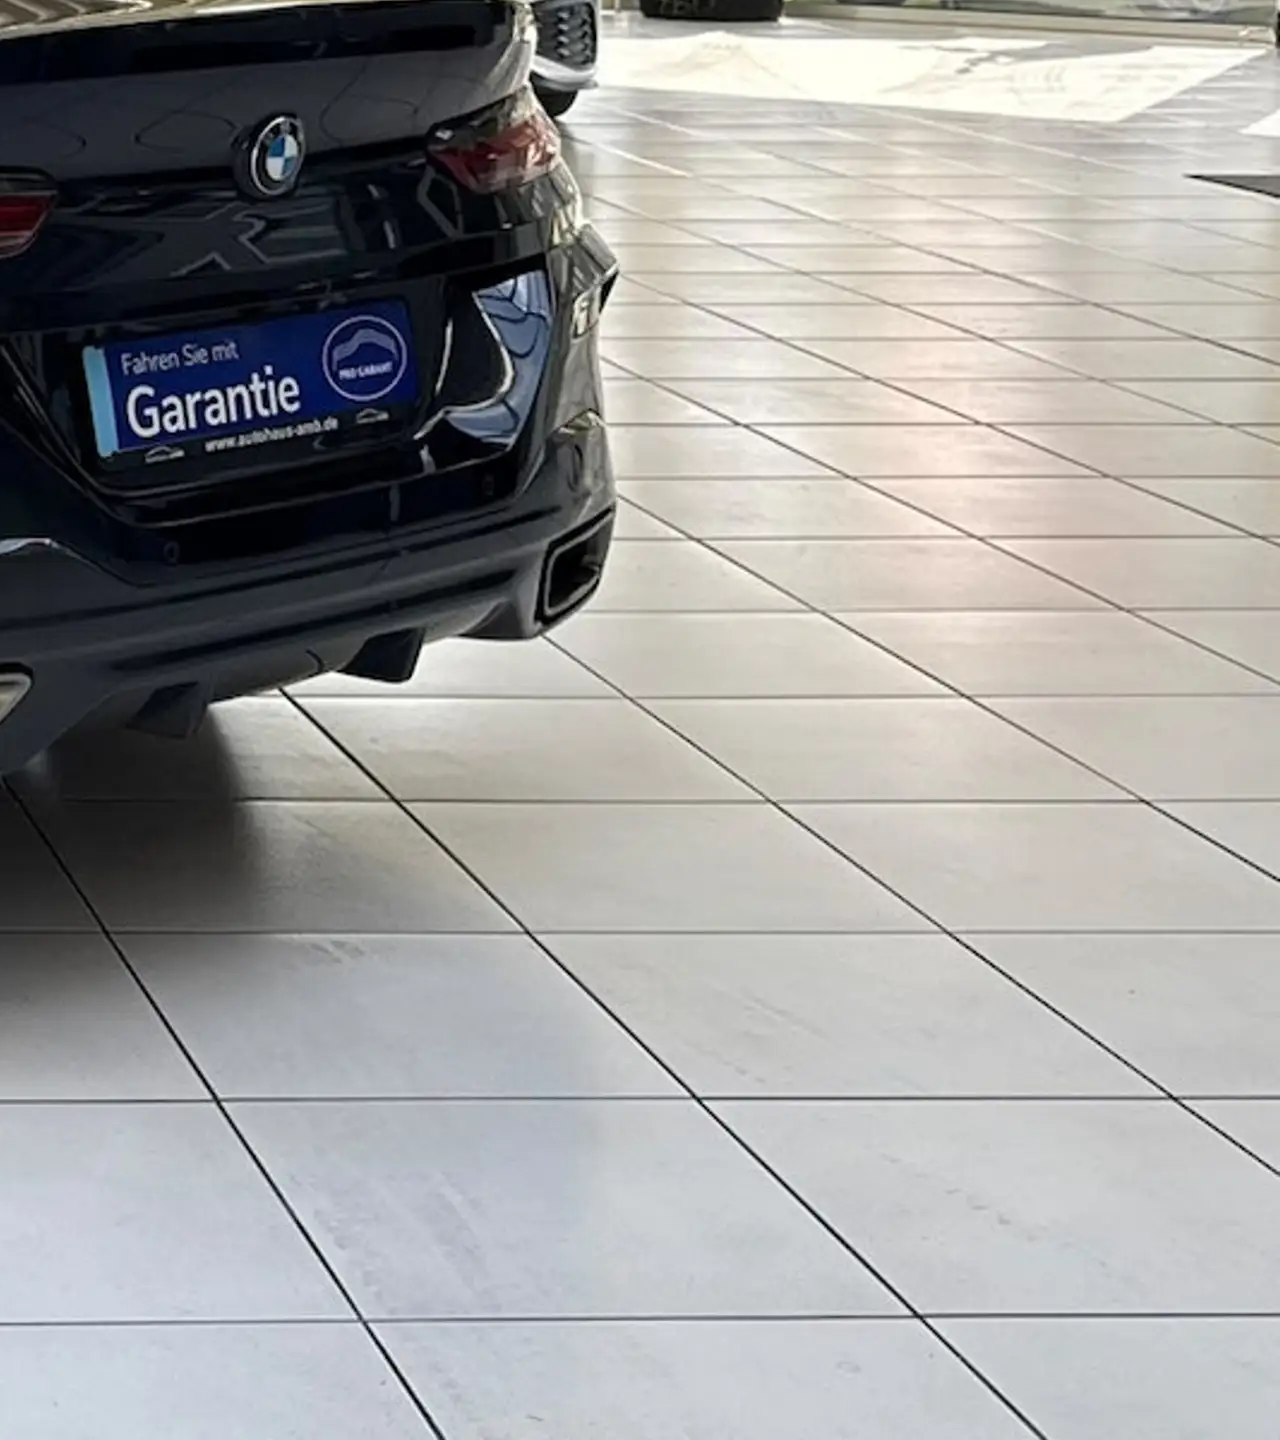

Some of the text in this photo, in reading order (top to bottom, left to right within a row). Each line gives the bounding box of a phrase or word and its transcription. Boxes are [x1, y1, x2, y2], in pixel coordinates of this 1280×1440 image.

[121, 340, 239, 376] Fahren Sie mit
[126, 365, 301, 438] Garantie
